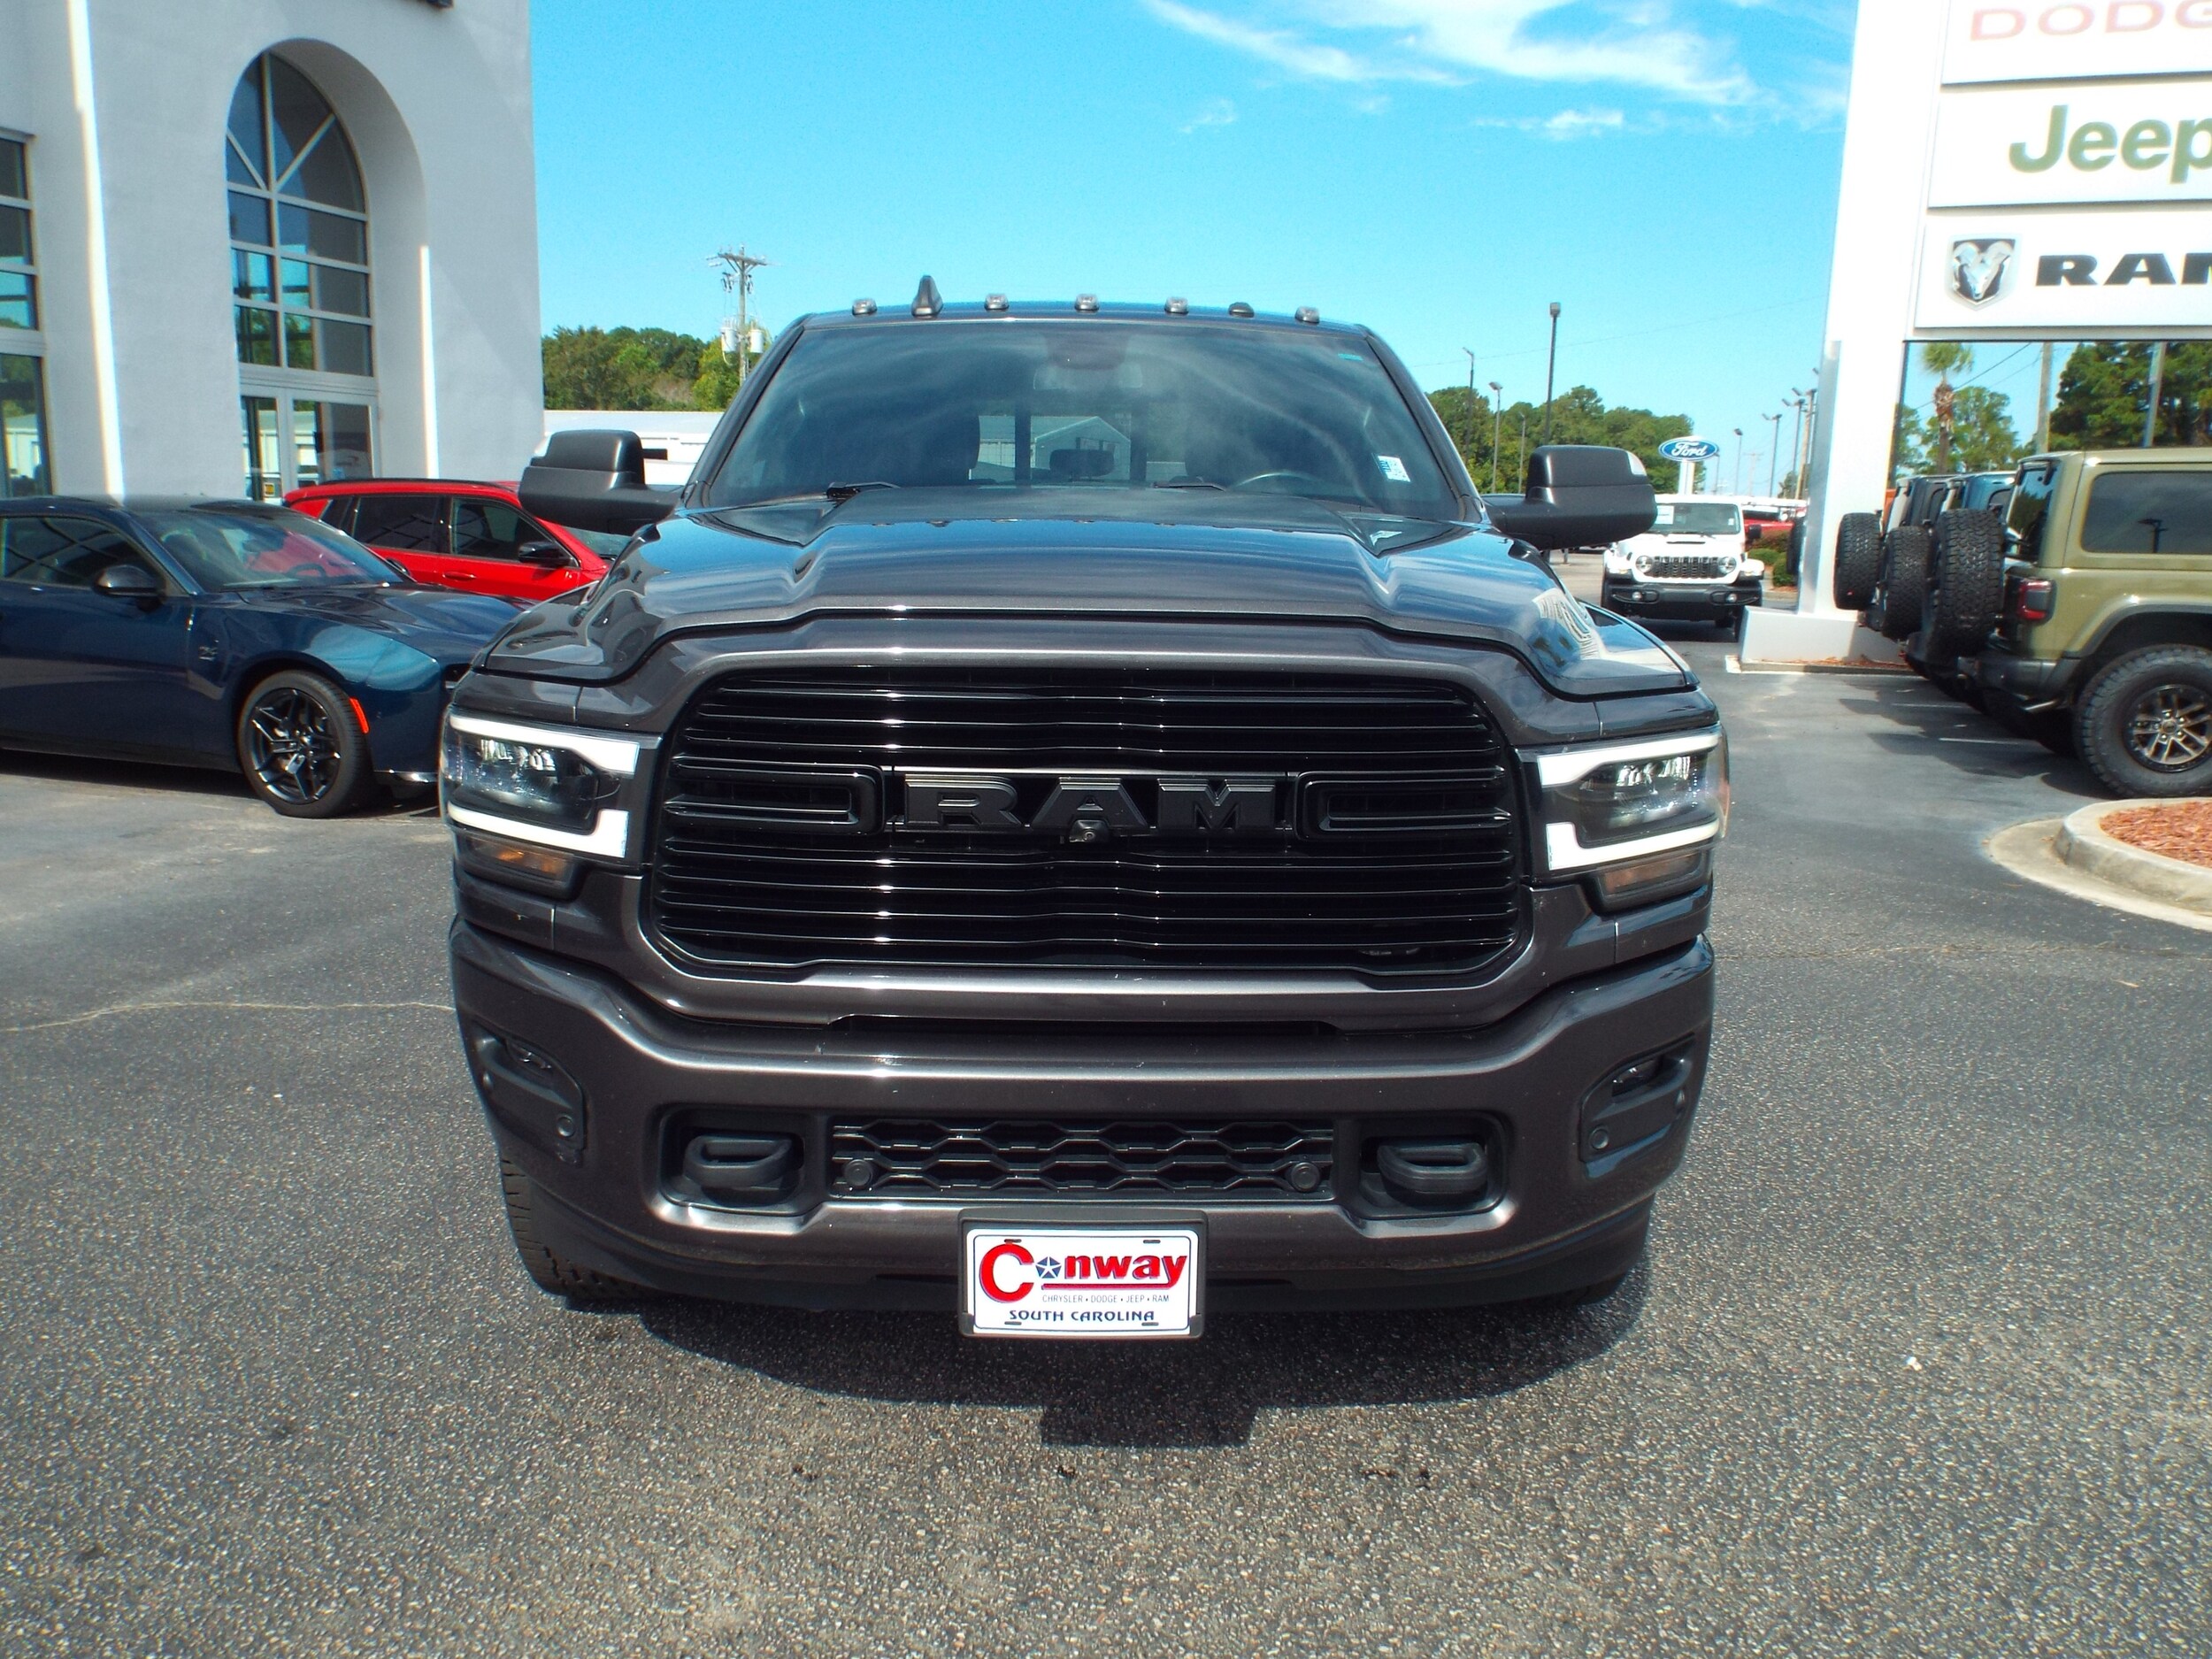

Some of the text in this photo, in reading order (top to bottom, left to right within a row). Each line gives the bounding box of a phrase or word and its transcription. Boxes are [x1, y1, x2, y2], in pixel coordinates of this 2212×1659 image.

[2008, 104, 2212, 184] Jeep
[1671, 442, 1709, 457] Ford
[904, 774, 1276, 828] RAM
[1041, 1294, 1083, 1303] CHRYSLER
[1090, 1294, 1118, 1303] DODGE
[1125, 1294, 1145, 1303] JEEP
[1009, 1310, 1155, 1322] SOUTH CAROLINA
